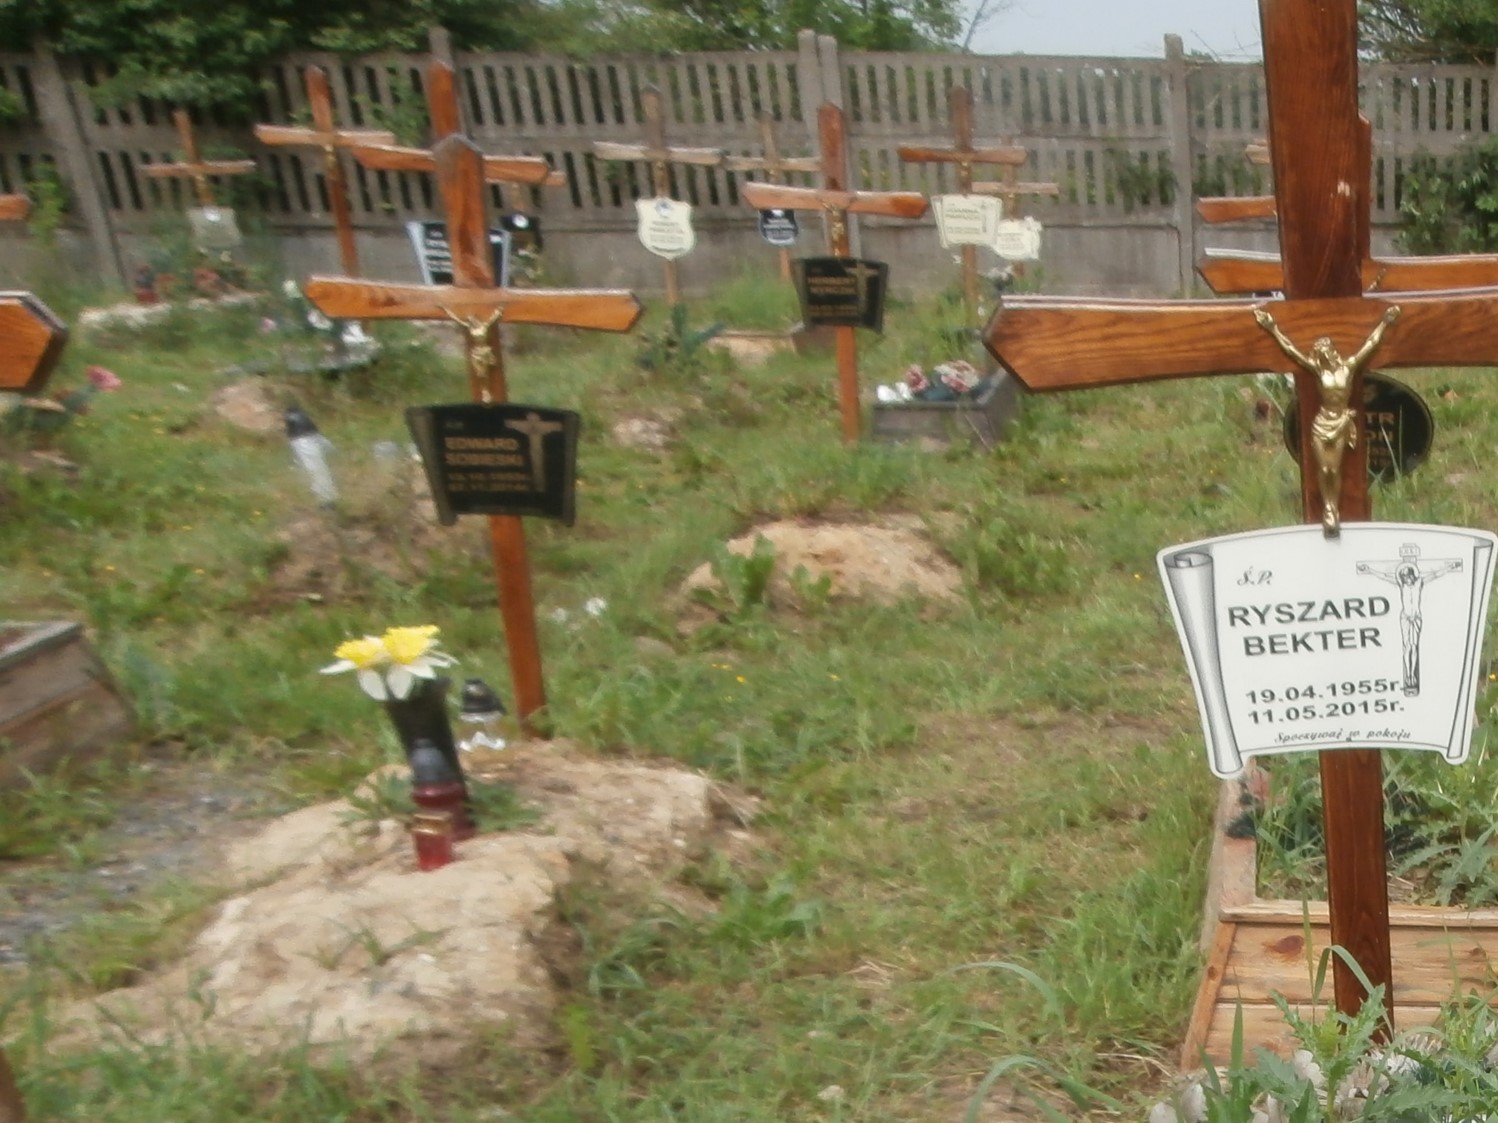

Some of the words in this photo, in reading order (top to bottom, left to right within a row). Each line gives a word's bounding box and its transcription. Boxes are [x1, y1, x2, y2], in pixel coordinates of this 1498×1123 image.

[1228, 596, 1391, 627] RYSZARD
[1243, 627, 1383, 656] BEKTER
[1246, 678, 1405, 704] 19.04.1955r.
[1248, 699, 1405, 725] 11.05.2015r.
